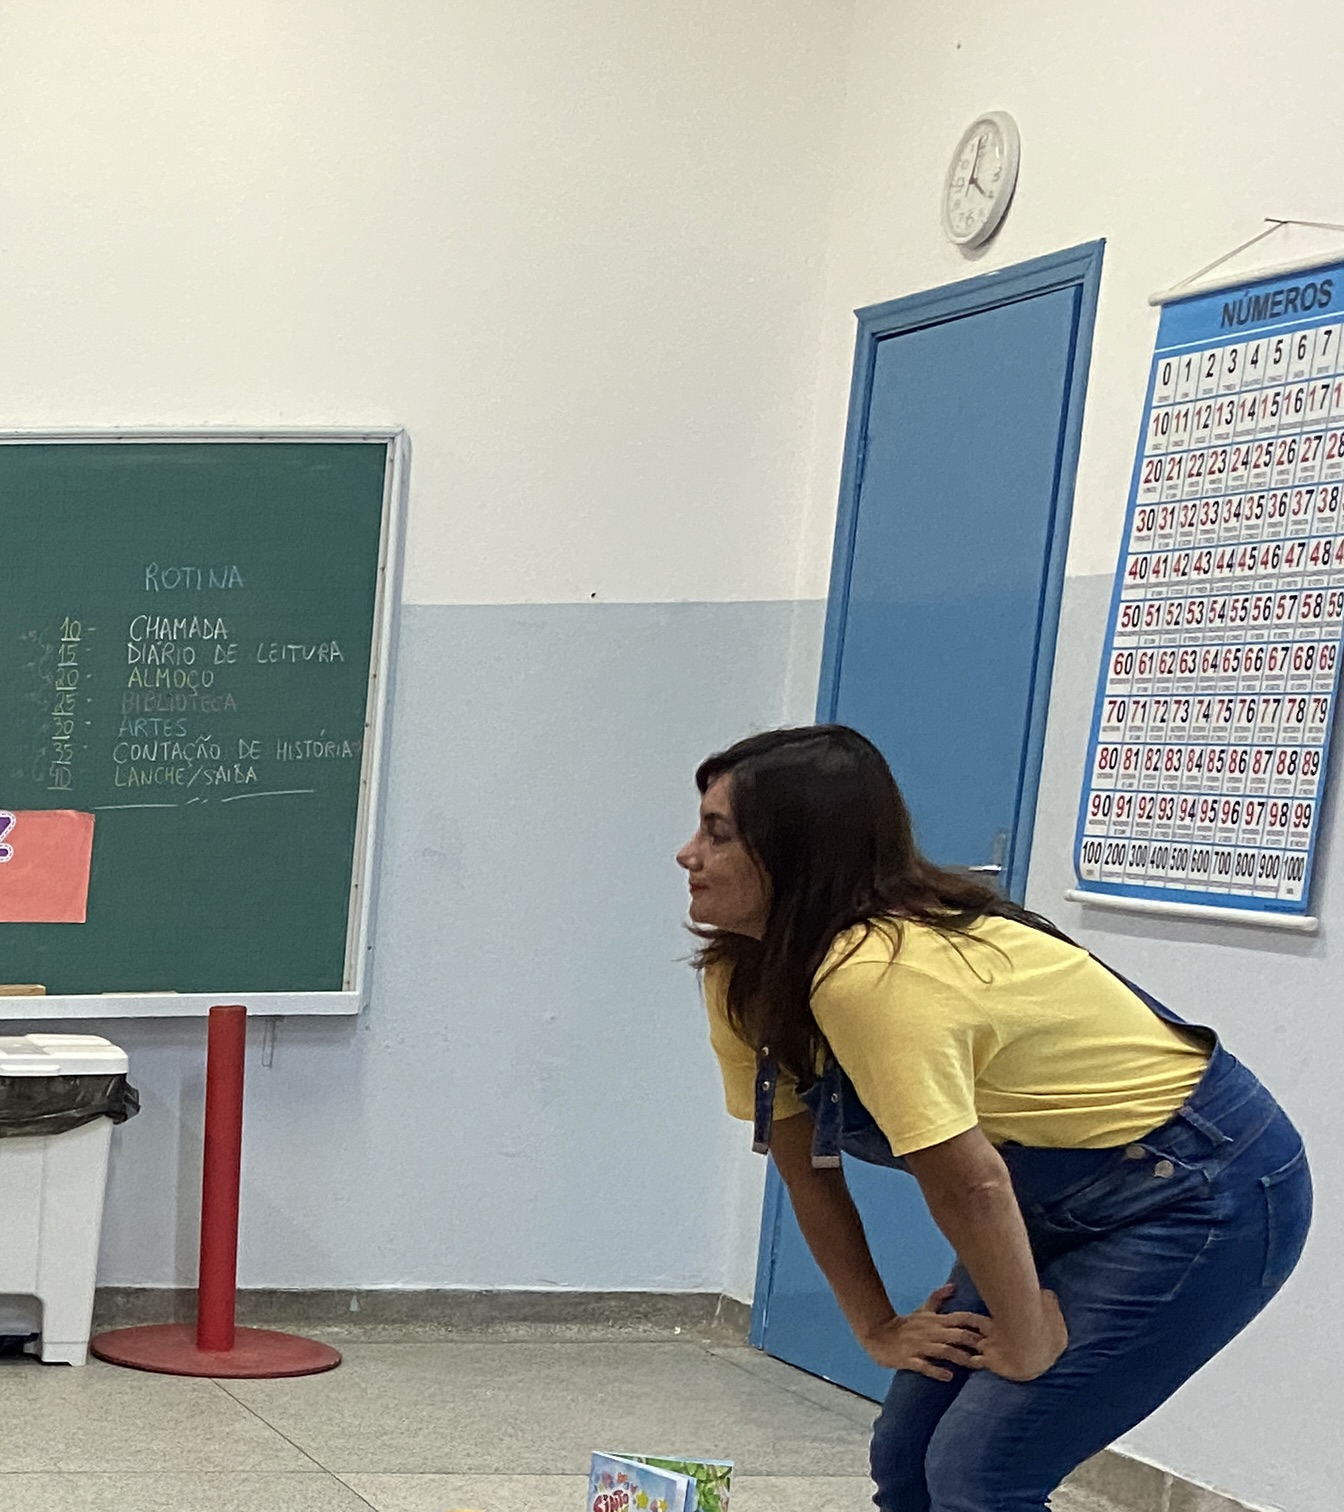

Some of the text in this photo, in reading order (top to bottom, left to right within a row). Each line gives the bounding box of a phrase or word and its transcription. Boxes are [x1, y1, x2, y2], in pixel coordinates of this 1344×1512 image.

[1220, 279, 1334, 328] NÚMEROS
[1162, 330, 1332, 386] 0 1 2 3 4 5 6 7
[1153, 384, 1329, 436] 10 11 12 13 14 15 16 17
[145, 562, 244, 592] ROTINA
[1121, 592, 1344, 628] 50 51 52 53 54 55 56 57 58 59
[129, 614, 228, 641] CHAMADA
[128, 640, 196, 666] DIÁRIO
[214, 644, 238, 665] DE
[257, 641, 344, 664] LEITURA
[1114, 644, 1335, 675] 60 61 62 63 64 65 66 67 68 69
[128, 666, 214, 696] ALMOÇO
[1106, 698, 1326, 723] 70 71 72 73 74 75 76 77 78 79
[118, 717, 187, 737] ARTES
[113, 735, 220, 768] CONTAÇÃO
[238, 739, 261, 760] DE
[276, 729, 352, 761] HISTÓRIA
[1099, 747, 1319, 776] 80 81 82 83 84 85 86 87 88 89
[1091, 794, 1311, 828] 90 91 92 93 94 95 96 97 98 99
[1083, 841, 1304, 881] 100 200 300 400 500 600 700 800 900 1000
